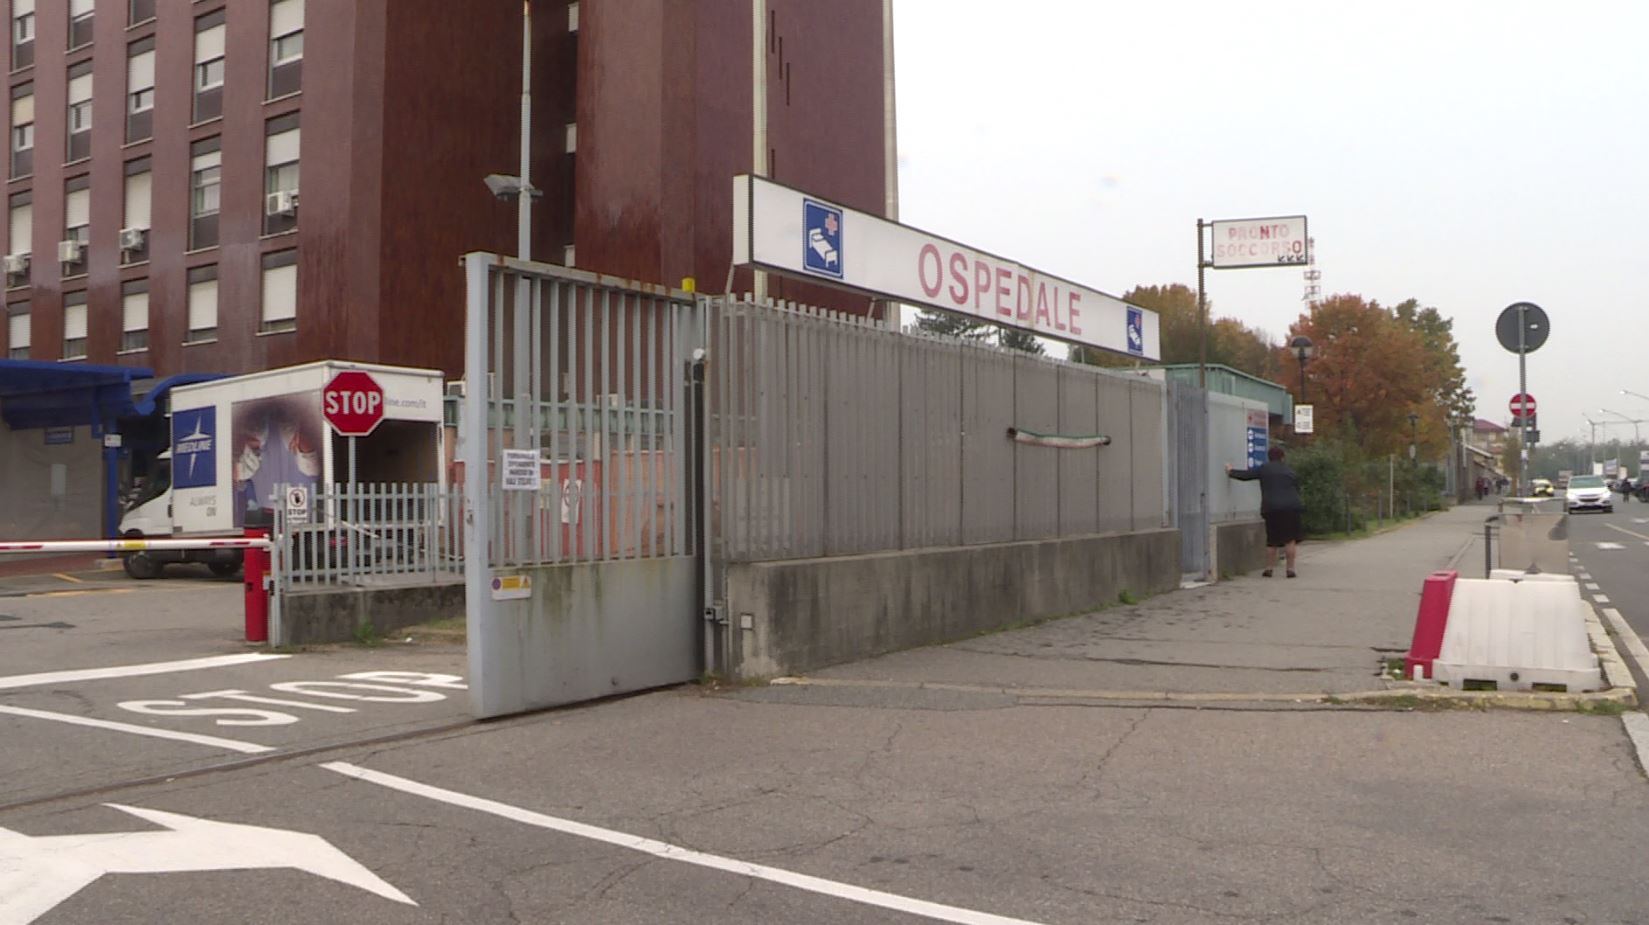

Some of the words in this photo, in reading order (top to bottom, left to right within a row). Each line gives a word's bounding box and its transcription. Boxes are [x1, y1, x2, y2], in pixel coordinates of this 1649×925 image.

[1228, 224, 1290, 240] PRONTO
[1216, 240, 1302, 257] SOCCORSO
[918, 243, 1082, 335] OSPEDALE
[325, 391, 380, 415] STOP
